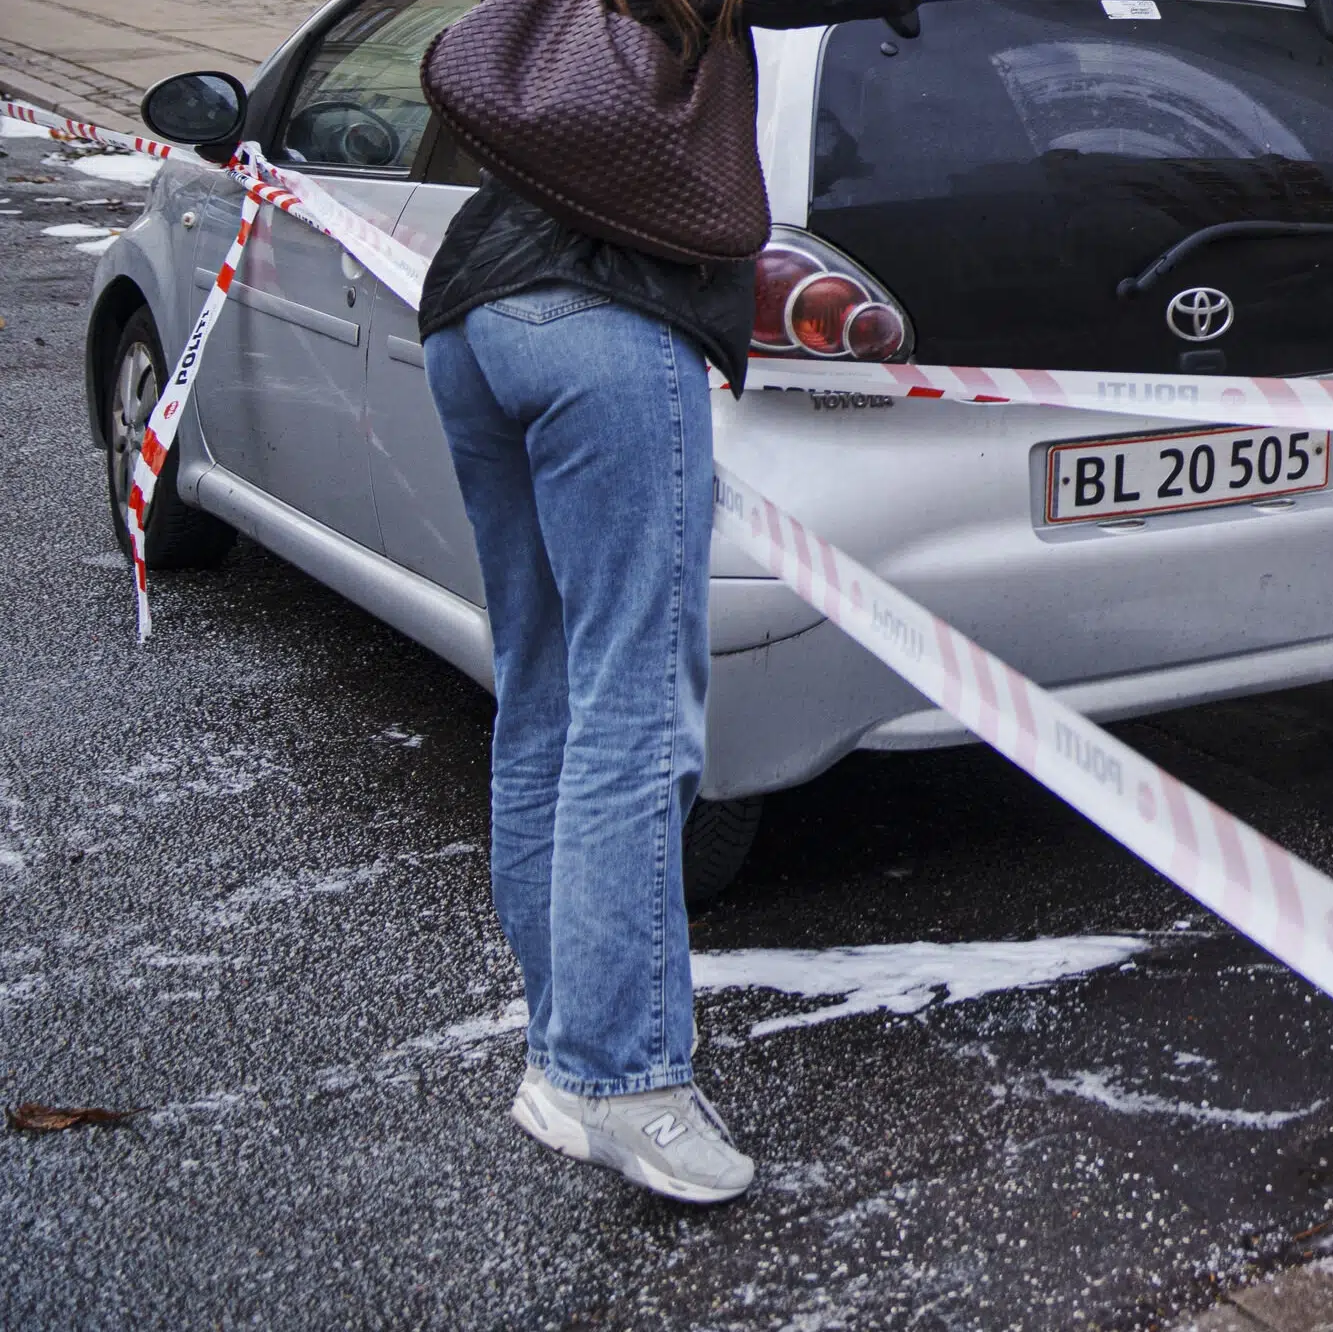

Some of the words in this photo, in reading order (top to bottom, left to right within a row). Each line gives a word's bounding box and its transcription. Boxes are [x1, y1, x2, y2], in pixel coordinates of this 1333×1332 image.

[811, 392, 894, 410] TOYOTA
[1075, 454, 1140, 507] BL
[1157, 444, 1215, 498] 20
[1229, 432, 1310, 489] 505
